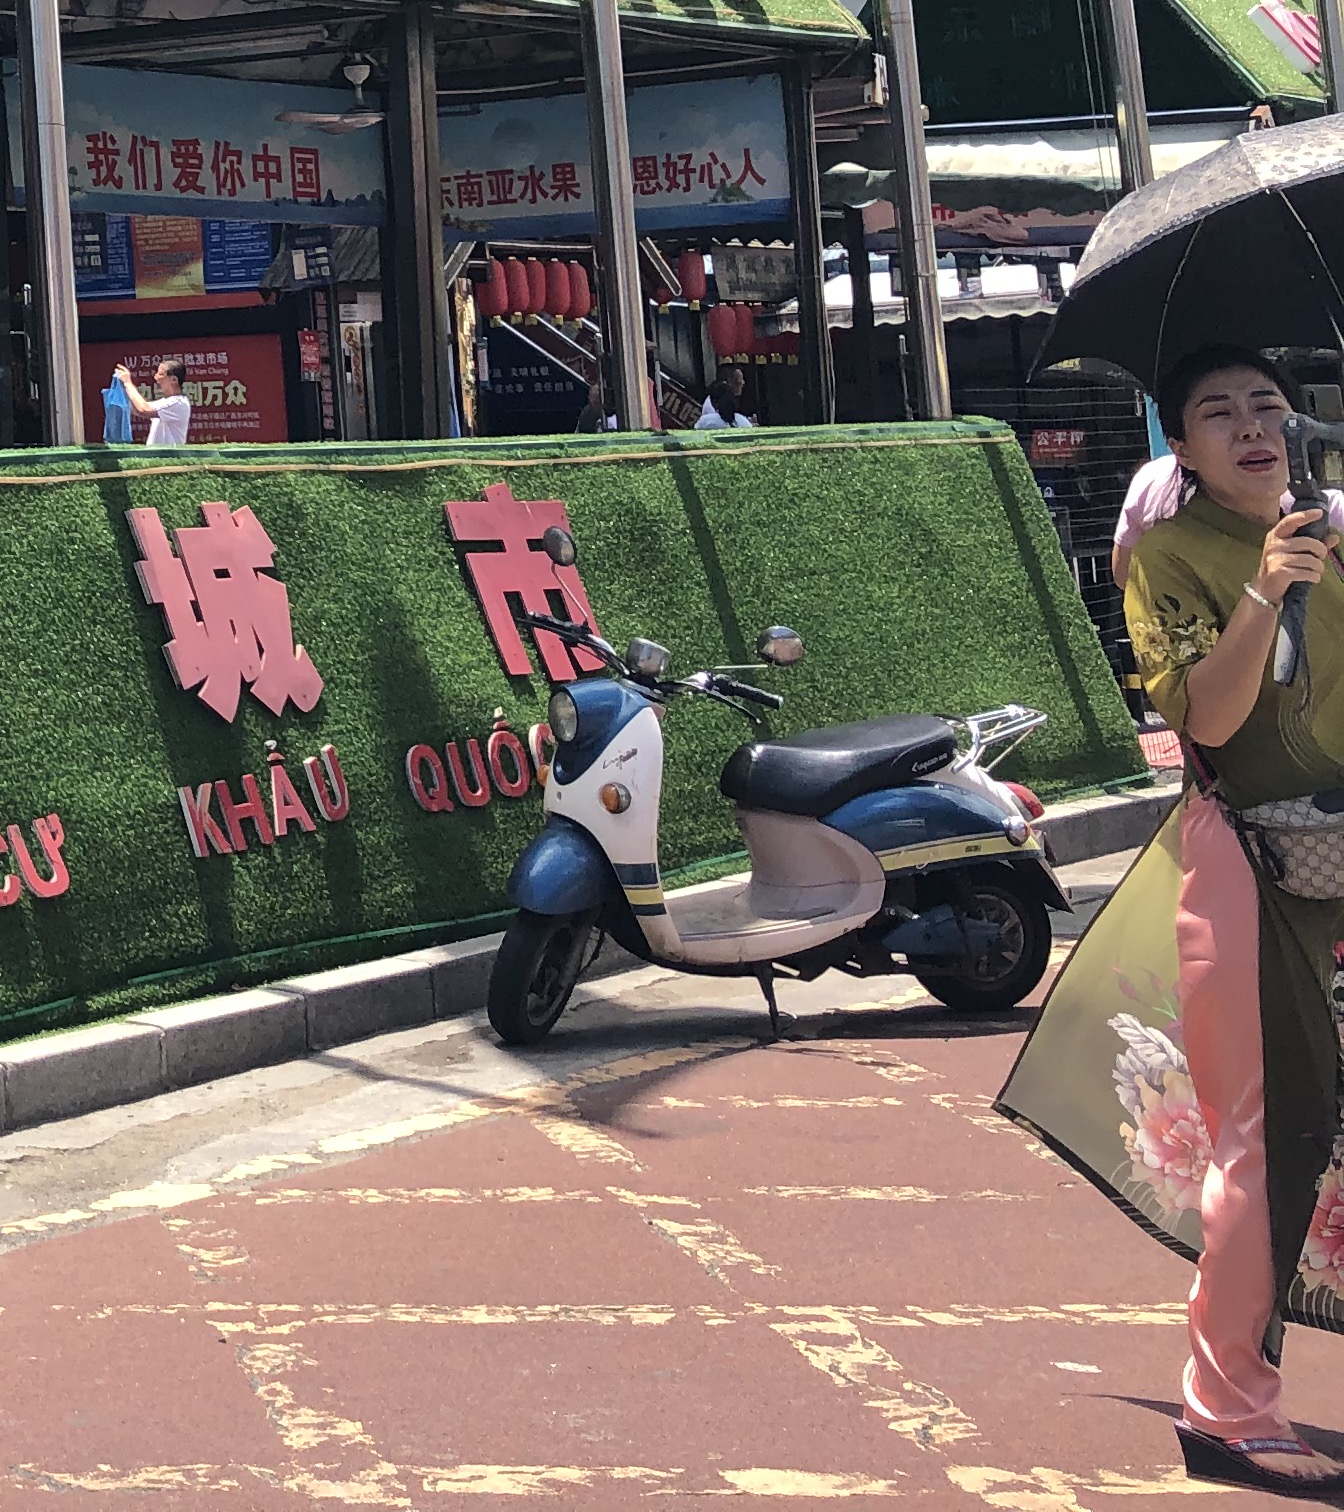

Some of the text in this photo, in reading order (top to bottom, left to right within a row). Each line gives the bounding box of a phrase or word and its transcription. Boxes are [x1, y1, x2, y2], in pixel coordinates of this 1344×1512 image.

[86, 131, 322, 201] 我们爱你中国
[439, 146, 768, 211] 东南亚水果 恩好心人
